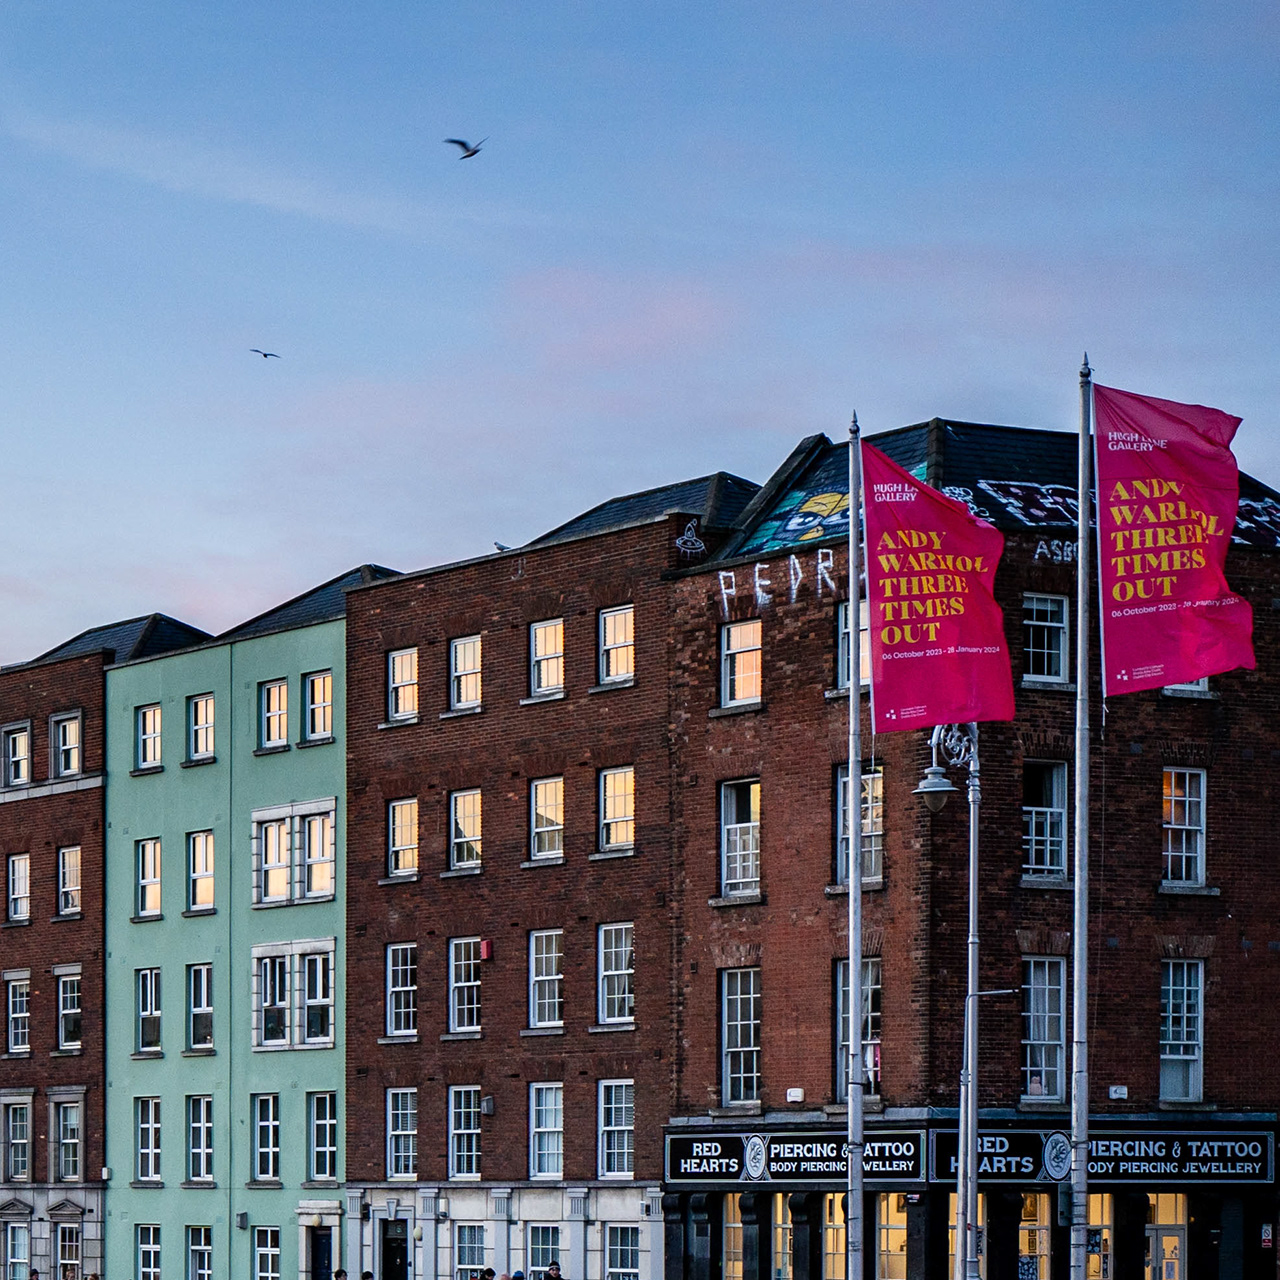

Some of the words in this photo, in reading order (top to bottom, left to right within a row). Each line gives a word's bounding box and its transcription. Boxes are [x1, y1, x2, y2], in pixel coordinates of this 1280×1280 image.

[1108, 431, 1139, 442] HUGH
[1108, 441, 1154, 452] GALLERY
[873, 483, 902, 493] HUGH
[874, 492, 918, 502] GALLERY
[877, 530, 947, 550] ANDY
[1110, 524, 1209, 552] THREE
[877, 552, 989, 573] WARHOL
[1111, 548, 1206, 577] TIMES
[719, 548, 837, 621] PEDR
[879, 574, 969, 597] THREE
[1112, 576, 1177, 602] OUT
[880, 597, 965, 621] TIMES
[1111, 610, 1122, 618] 06
[1123, 605, 1157, 616] October
[1158, 603, 1177, 612] 2023
[1222, 597, 1239, 605] 2024
[881, 622, 940, 645] OUT
[882, 652, 892, 660] 06
[893, 649, 924, 659] October
[925, 647, 942, 656] 2023
[956, 645, 982, 653] January
[692, 1142, 721, 1156] RED
[770, 1143, 837, 1158] PIERCING
[863, 1142, 915, 1157] ATTOO
[1088, 1141, 1166, 1157] IERCING
[1172, 1141, 1181, 1158] &
[1187, 1141, 1262, 1157] TATTOO
[680, 1158, 739, 1173] HEARTS
[770, 1162, 797, 1172] BODY
[800, 1161, 847, 1172] PIERCING
[862, 1161, 914, 1171] WELLERY
[950, 1156, 1034, 1173] HARTS
[1087, 1162, 1115, 1173] ODY
[1119, 1162, 1179, 1173] PIERCING
[1182, 1162, 1262, 1174] JEWELLERY
